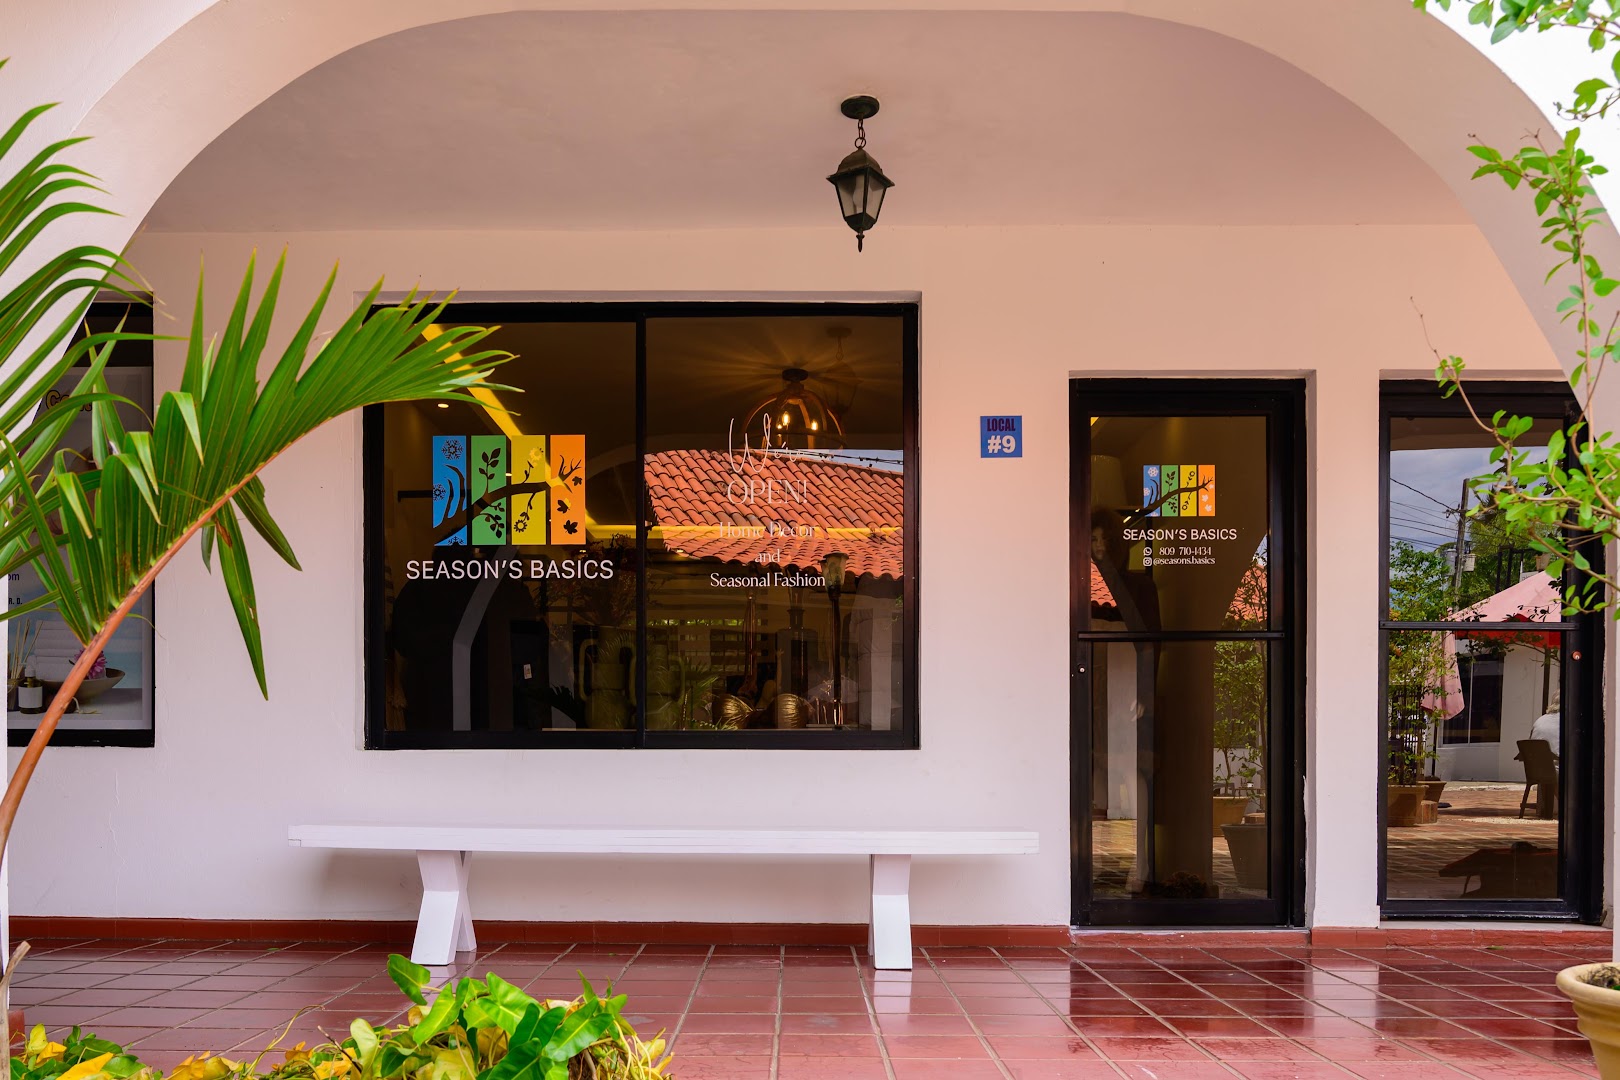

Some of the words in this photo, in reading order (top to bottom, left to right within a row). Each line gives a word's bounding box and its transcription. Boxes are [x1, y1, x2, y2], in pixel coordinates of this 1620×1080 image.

[987, 418, 1016, 432] LOCAL
[988, 435, 1016, 454] #9
[727, 479, 808, 504] OPEN!
[719, 522, 765, 539] Home
[770, 522, 815, 539] Decor
[1122, 528, 1187, 540] SEASON'S
[1190, 528, 1238, 540] BASICS
[754, 548, 781, 563] and
[1159, 547, 1175, 556] 809
[1179, 547, 1212, 556] 710-1434
[1153, 556, 1216, 566] @seasons.basics
[406, 559, 523, 580] SEASON'S
[530, 559, 614, 580] BASICS
[710, 572, 771, 588] Seasonal
[774, 572, 826, 588] Fashion
